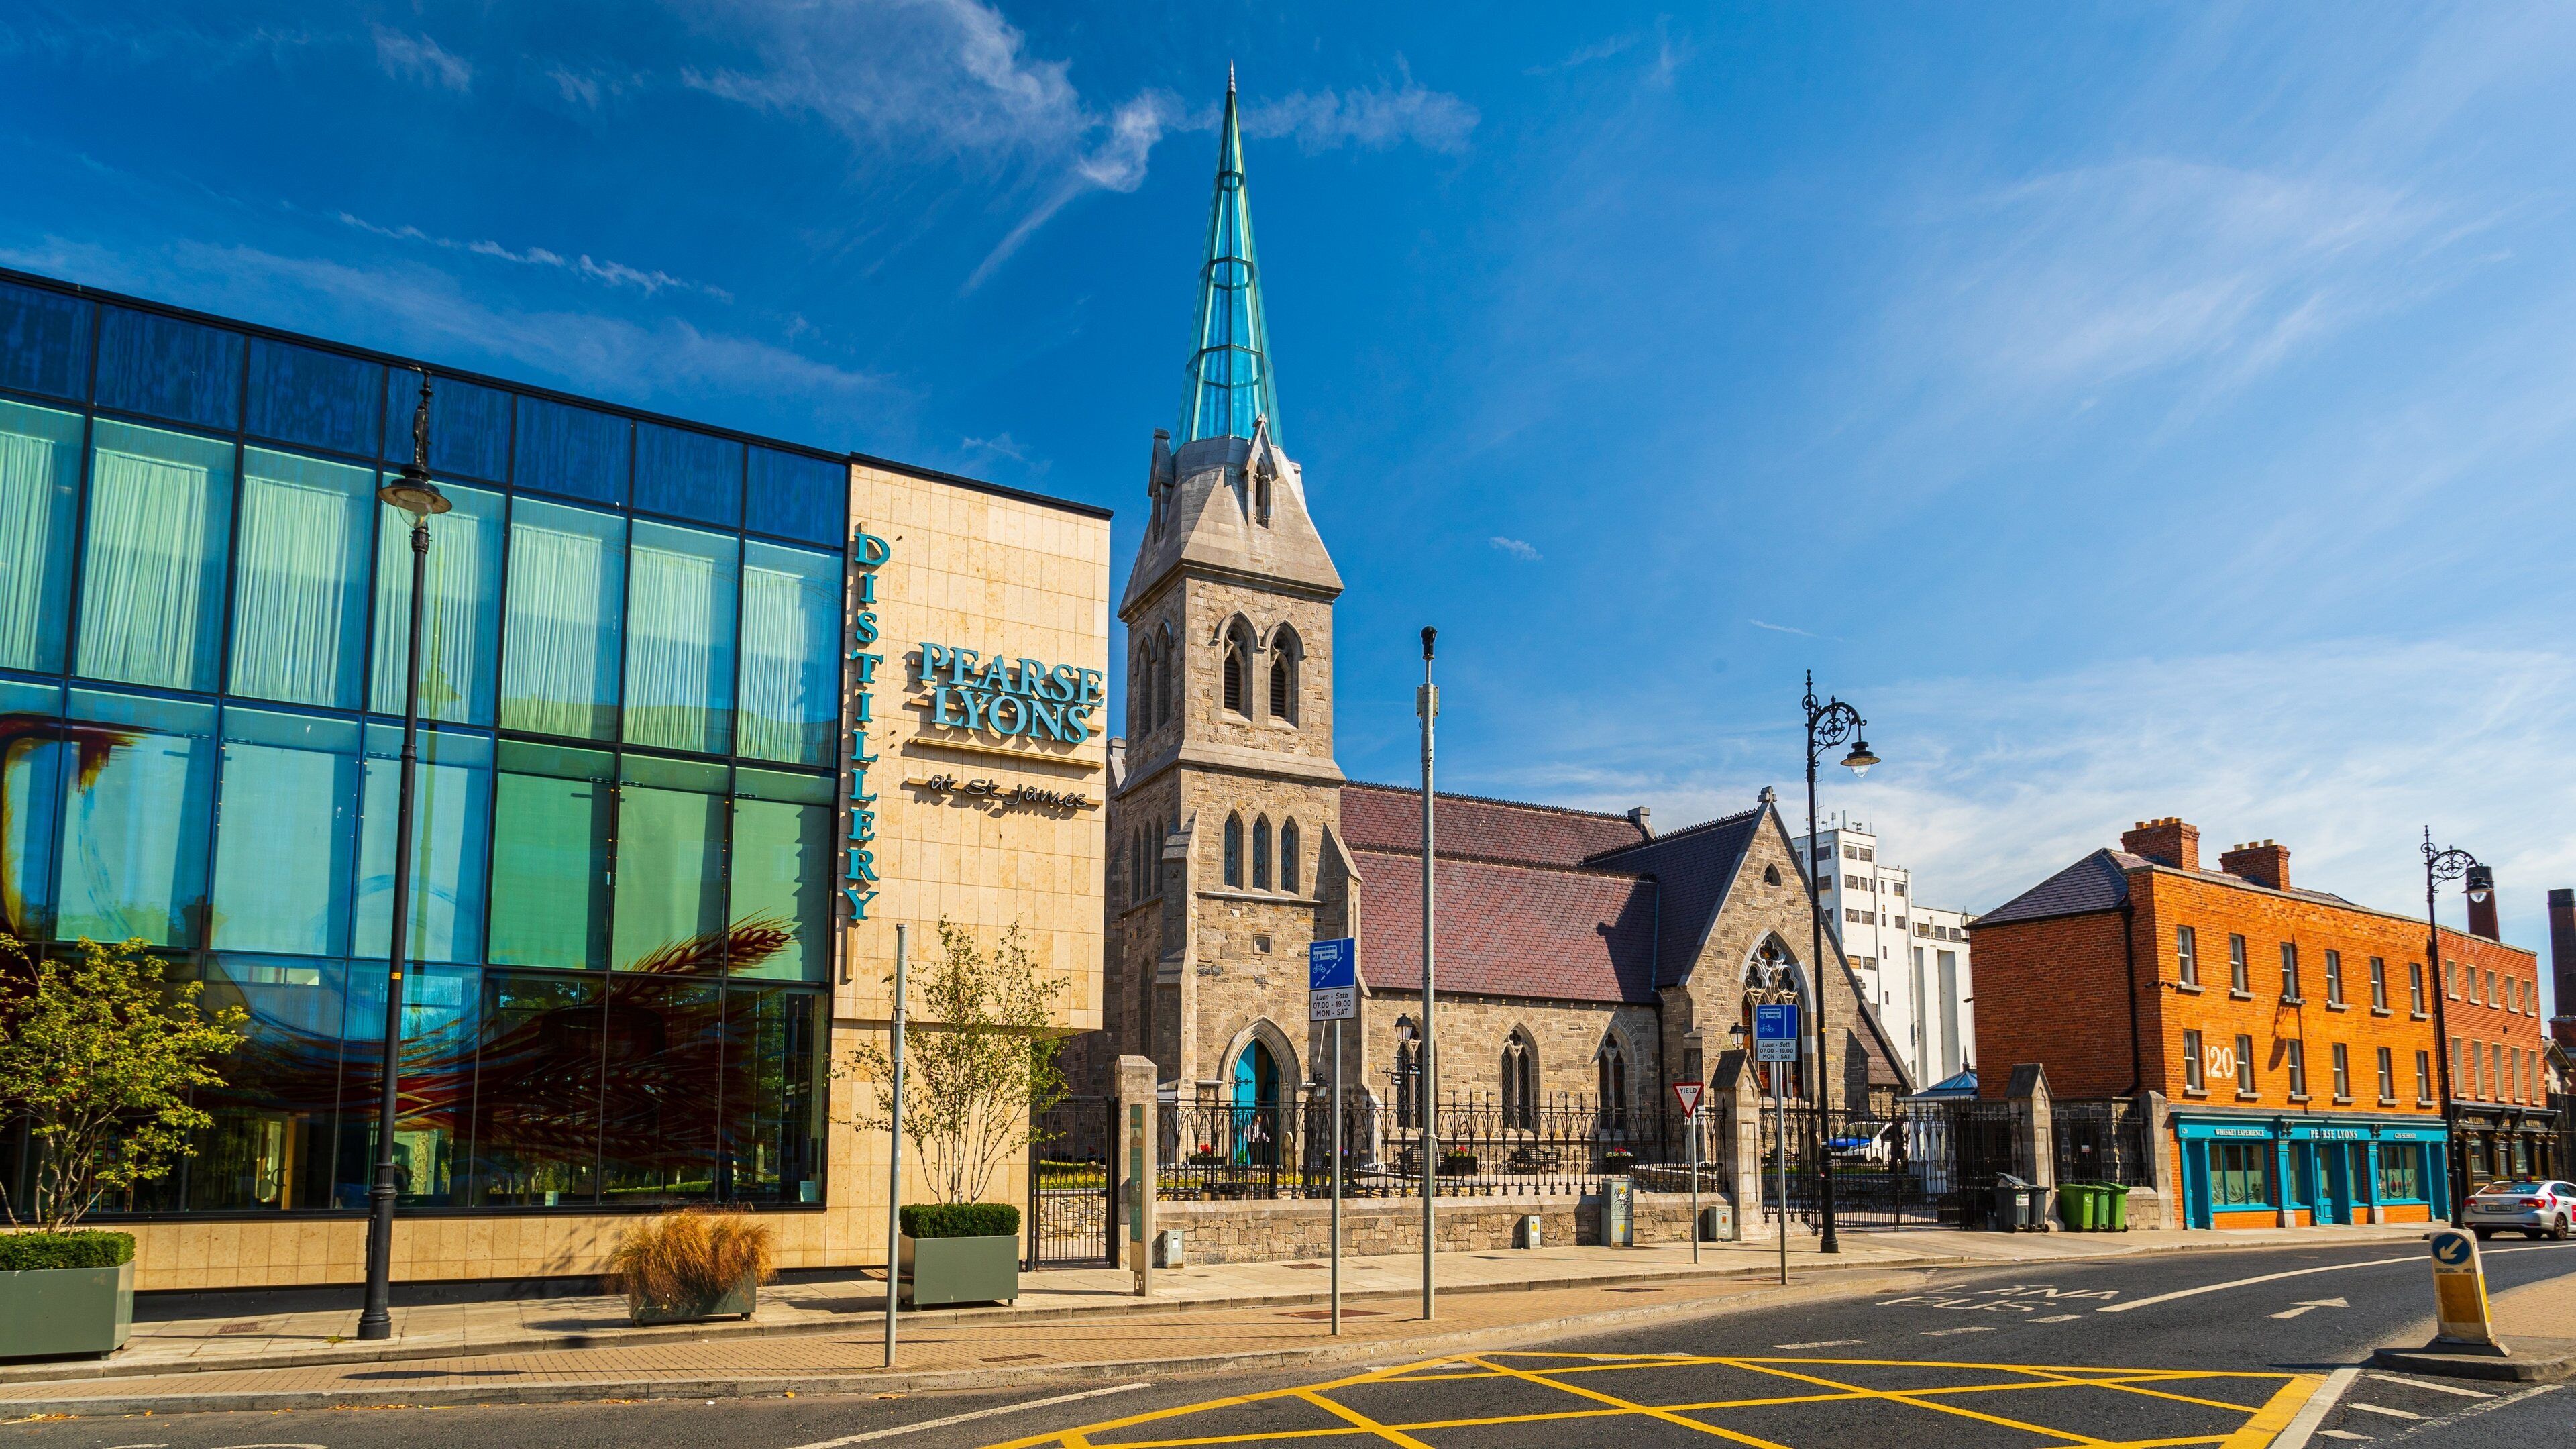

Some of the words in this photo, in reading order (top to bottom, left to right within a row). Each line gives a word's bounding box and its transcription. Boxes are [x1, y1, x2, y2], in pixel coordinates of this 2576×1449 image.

[918, 642, 1104, 708] PEARSE
[843, 532, 890, 920] DISTILLERY
[931, 685, 1091, 744] LYONS
[930, 773, 957, 792] at
[965, 778, 1006, 798] St.
[2204, 1045, 2235, 1078] 120
[2310, 1129, 2334, 1138] PERSE
[2337, 1130, 2357, 1138] LYONS
[1876, 1295, 2057, 1312] BUS
